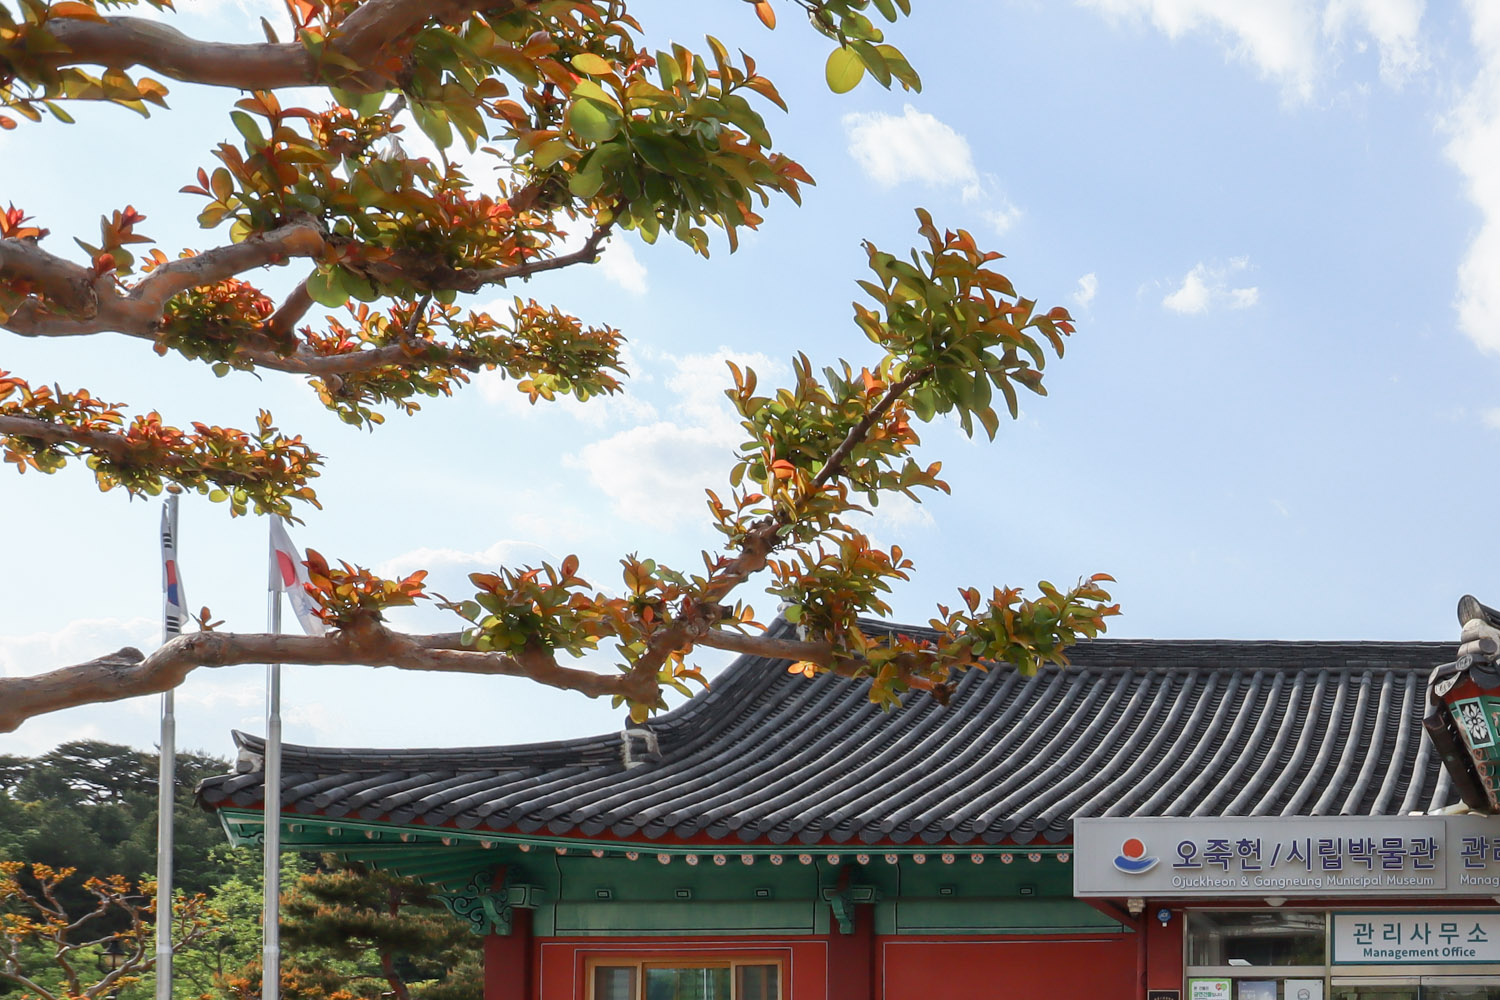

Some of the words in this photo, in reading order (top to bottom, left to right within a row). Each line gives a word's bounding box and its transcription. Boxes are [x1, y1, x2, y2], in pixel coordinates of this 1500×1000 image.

[1171, 836, 1439, 872] 오죽헌/시립박물관
[1172, 875, 1236, 889] Ojuckheon
[1240, 875, 1249, 887] &
[1254, 875, 1322, 889] Gangneung
[1326, 873, 1382, 888] Municipal
[1386, 874, 1434, 886] Museum
[1352, 922, 1489, 945] 관리사무소
[1363, 947, 1440, 960] Management
[1442, 946, 1476, 957] Office
